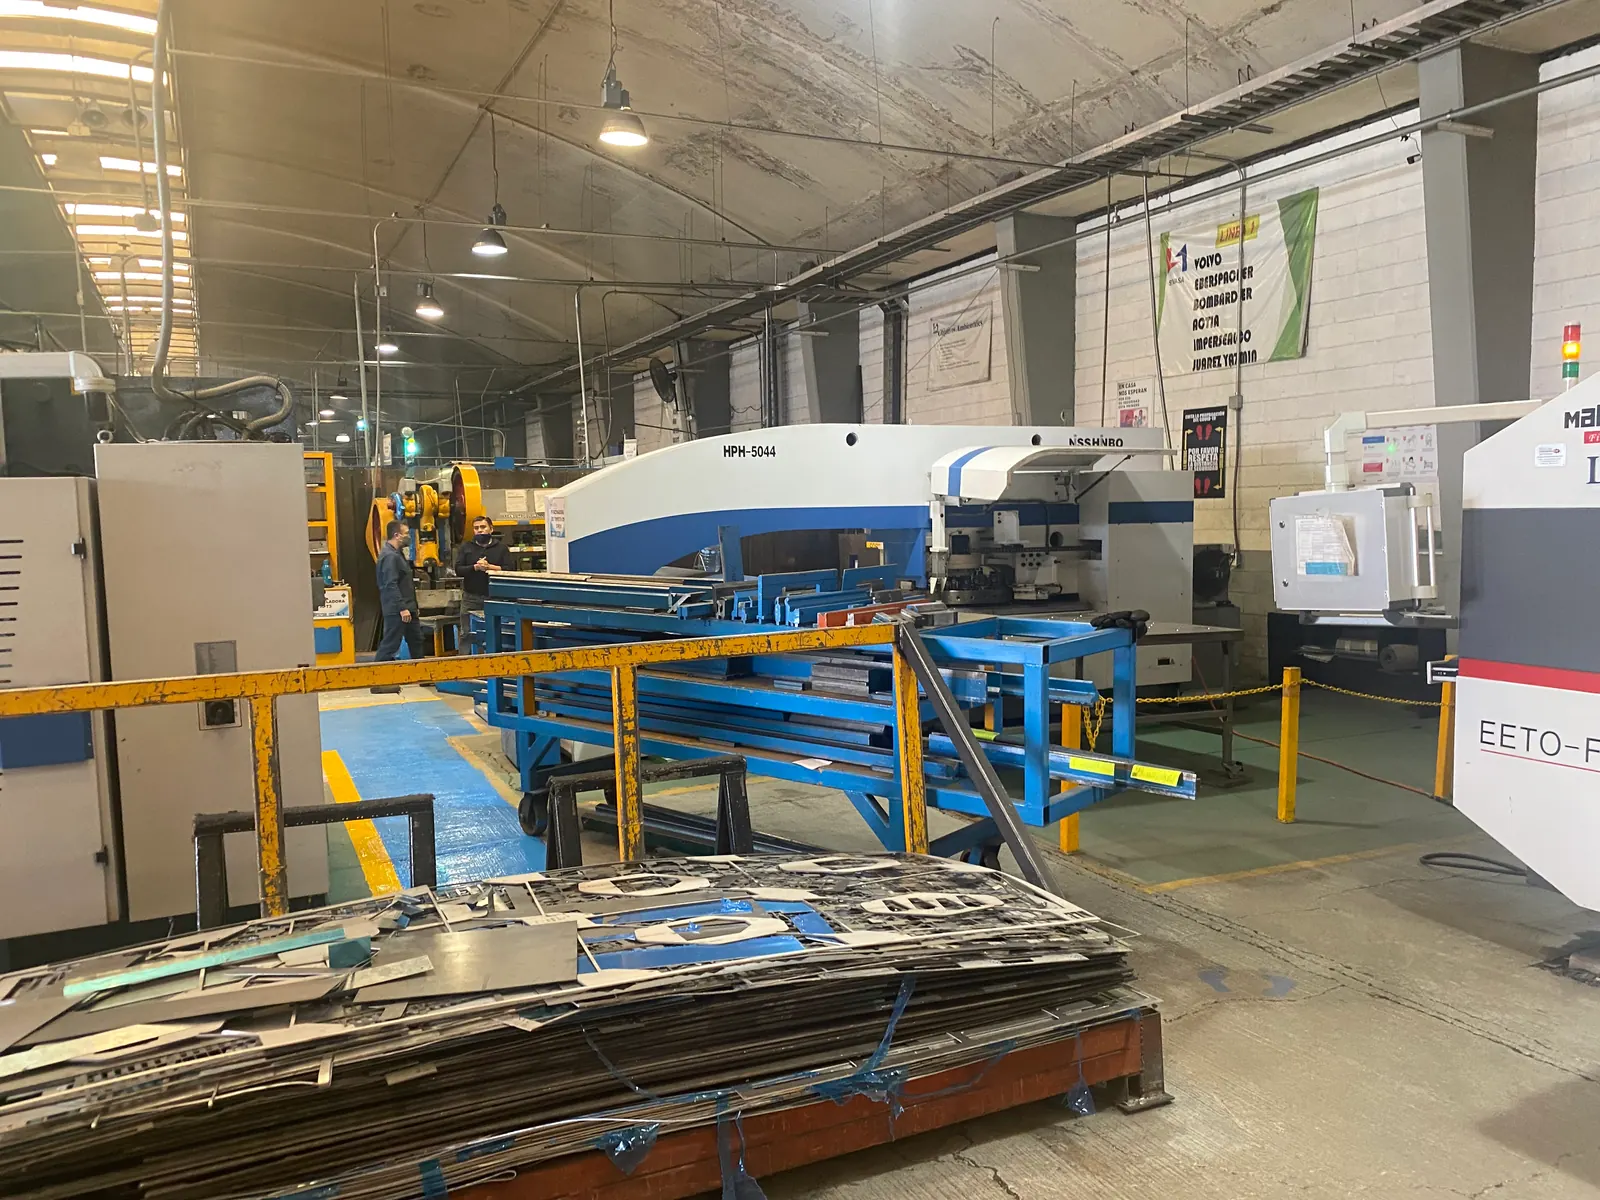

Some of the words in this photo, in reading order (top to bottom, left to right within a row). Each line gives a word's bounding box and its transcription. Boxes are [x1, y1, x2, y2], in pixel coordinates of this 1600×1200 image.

[1194, 252, 1222, 271] VOLVO
[1193, 287, 1253, 312] BOMBARDER
[1192, 355, 1222, 372] JUAREZ
[723, 445, 776, 458] HPH-5044
[1188, 447, 1199, 455] POR
[1200, 446, 1219, 454] FAVOR
[1188, 453, 1218, 462] RESPETA
